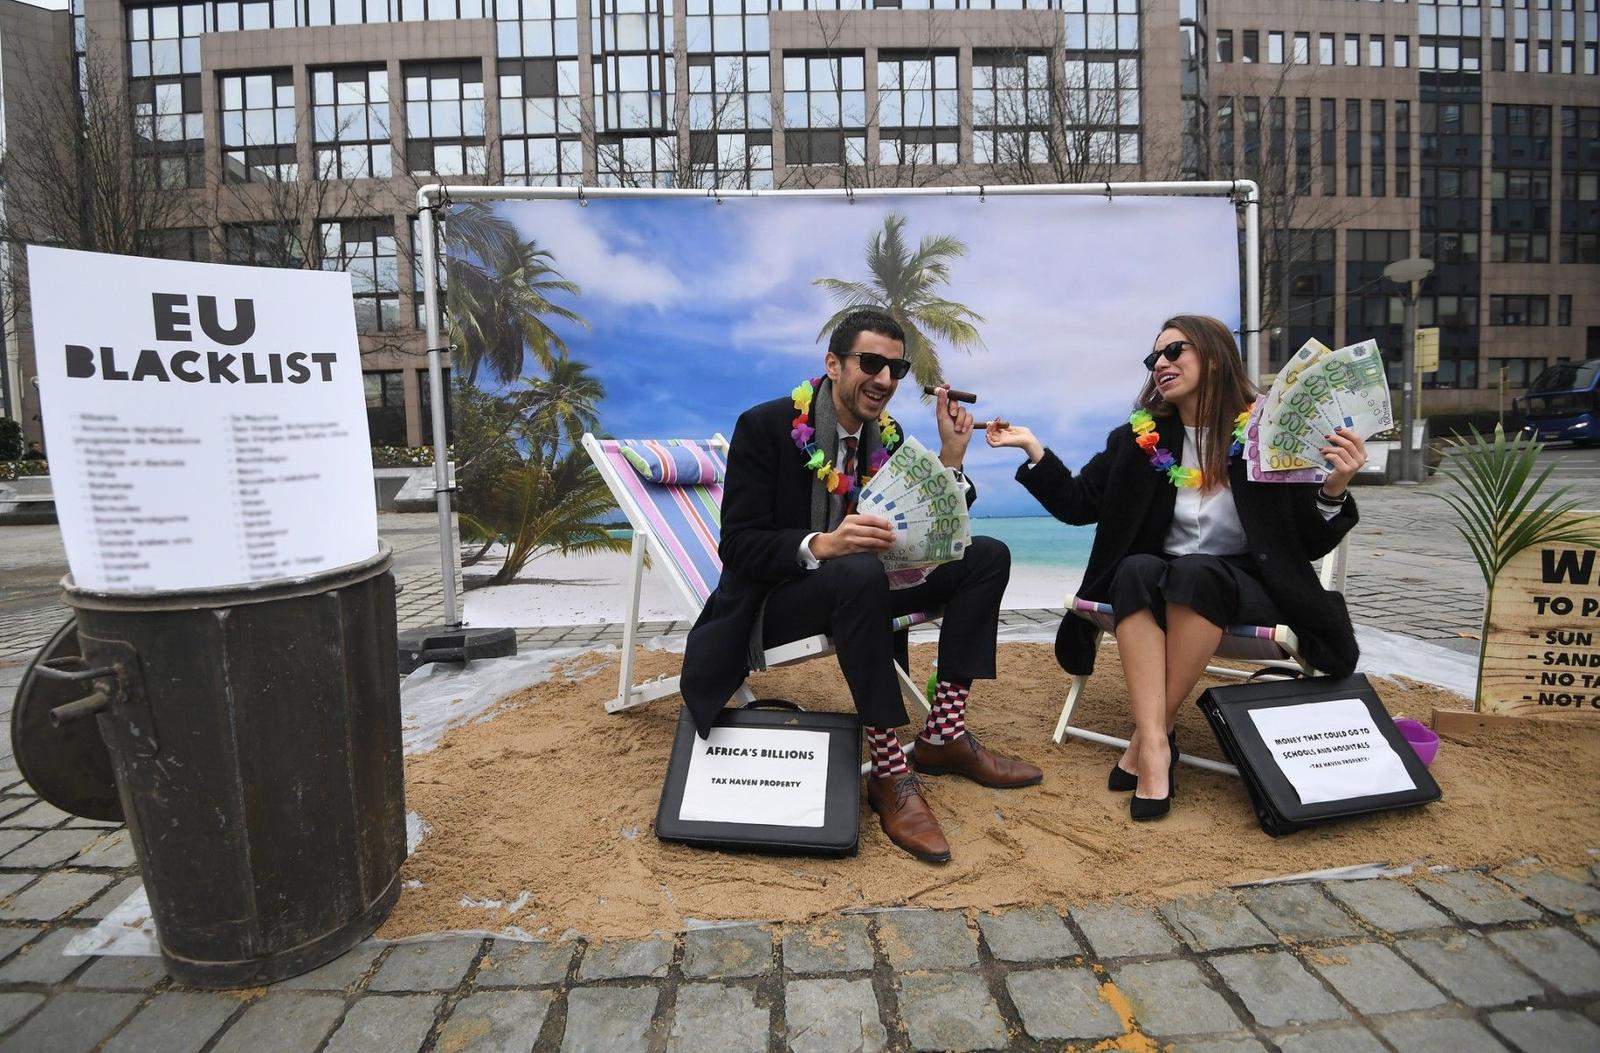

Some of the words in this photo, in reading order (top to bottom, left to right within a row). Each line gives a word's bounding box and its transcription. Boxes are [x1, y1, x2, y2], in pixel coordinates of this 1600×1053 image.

[152, 292, 256, 346] EU
[64, 344, 337, 384] BLACKLIST
[1304, 374, 1332, 402] 100
[1290, 393, 1319, 419] 100
[1279, 411, 1308, 437] 100
[1272, 431, 1304, 454] 100
[890, 445, 917, 473] 100
[905, 457, 933, 483] 100
[920, 473, 950, 498] 100
[931, 494, 959, 514] 100
[934, 517, 961, 533] 100
[1541, 549, 1600, 585] W
[1533, 596, 1573, 615] TO
[1581, 598, 1600, 617] P
[1545, 630, 1592, 646] SUN
[1543, 651, 1600, 668] SAND
[1541, 672, 1575, 687] NO
[1538, 692, 1585, 708] NOT
[1274, 736, 1301, 745] MONEY
[1303, 733, 1323, 742] THAT
[1324, 730, 1347, 739] COULD
[706, 746, 758, 757] AFRICA'S
[760, 749, 815, 761] BILLIONS
[1282, 748, 1316, 759] SCHOOLS
[1317, 746, 1332, 754] AND
[1332, 741, 1370, 753] HOSPITALS
[711, 777, 727, 785] TAX
[729, 778, 757, 786] HAVEN
[760, 780, 801, 788] PROPERTY
